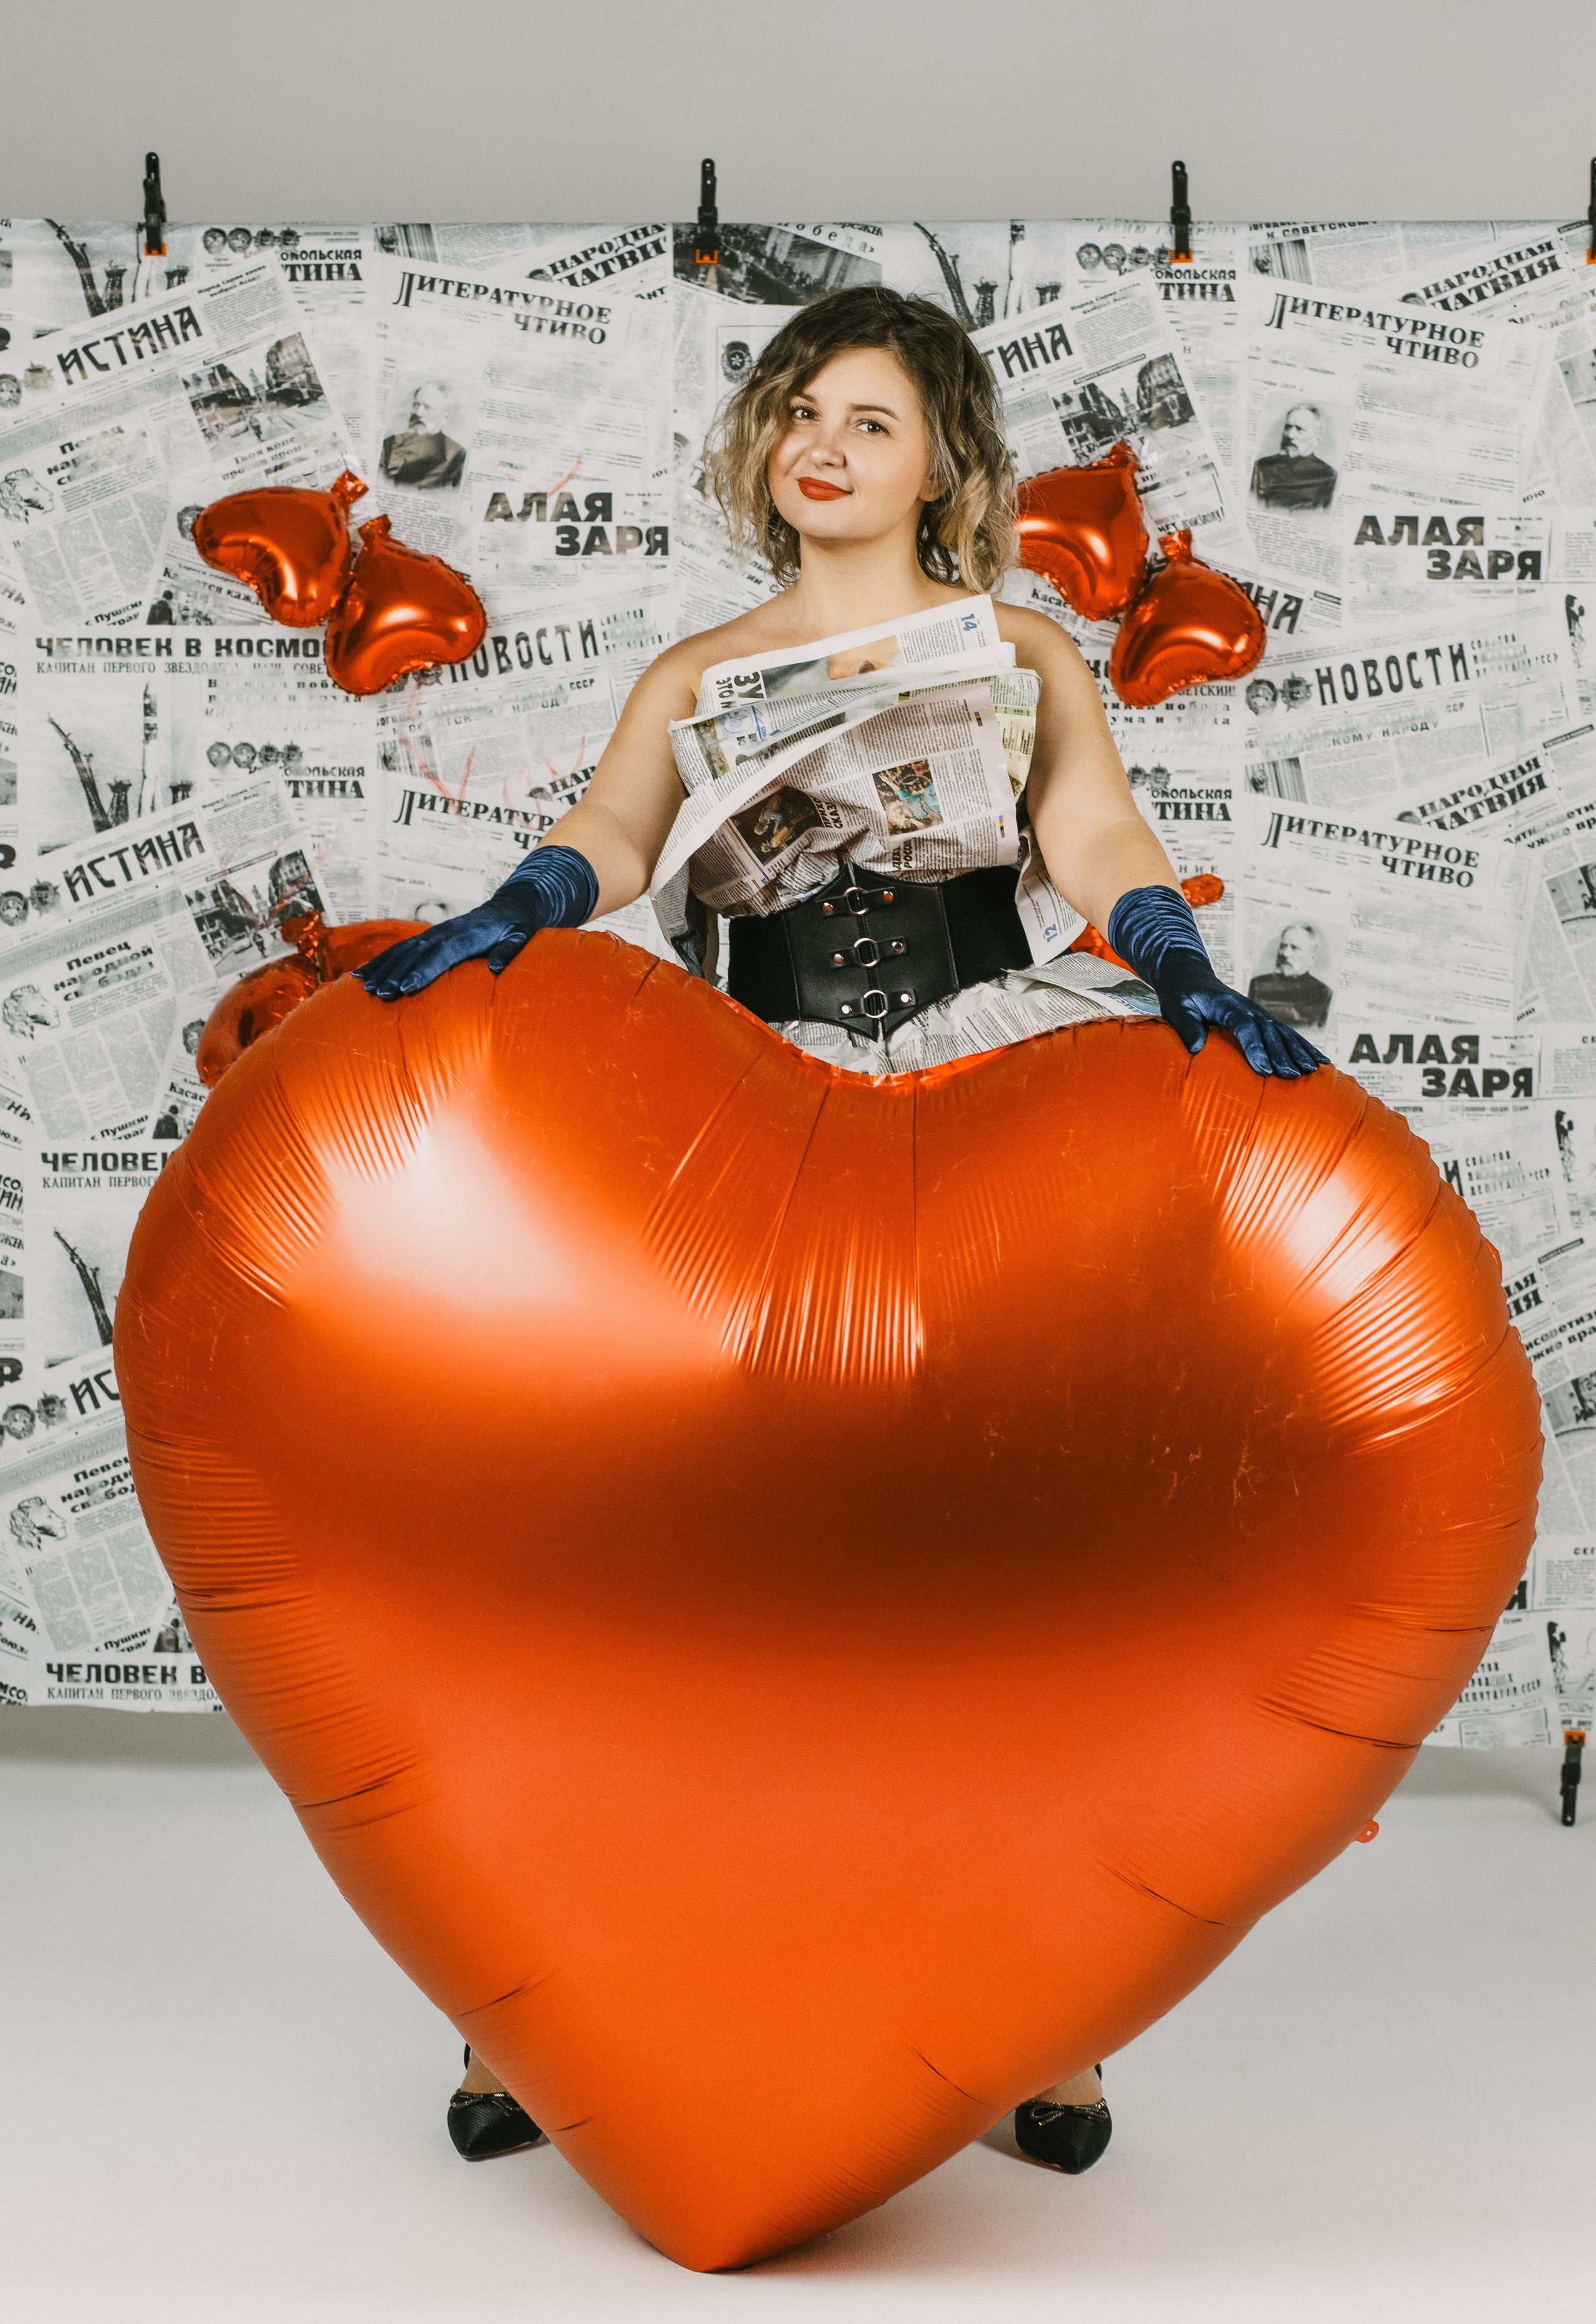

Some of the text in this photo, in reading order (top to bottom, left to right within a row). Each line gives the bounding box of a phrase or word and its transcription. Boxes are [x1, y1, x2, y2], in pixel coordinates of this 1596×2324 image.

[281, 249, 362, 261] ОМОЛЬСКАЯ
[549, 223, 666, 275] НАРОДНА
[557, 236, 666, 287] ЛАТВИ
[1153, 269, 1236, 281] ОМОЛЬСКАЯ
[1421, 241, 1555, 300] НАРОДНАЯ
[1430, 253, 1563, 312] ЛАТВИЯ
[393, 272, 611, 324] ЛИТЕРАТУРНОЕ
[513, 313, 607, 345] ЧТИВО
[1265, 293, 1485, 349] ЛИТЕРАТУРНОЕ
[57, 306, 203, 386] ИСТИНА
[1385, 336, 1479, 370] ЧТИВО
[483, 492, 613, 522] АЛАЯ
[555, 526, 669, 556] ЗАРЯ
[1353, 515, 1484, 546] АЛАЯ
[1427, 549, 1542, 580] ЗАРЯ
[961, 613, 978, 632] 14
[36, 638, 326, 658] ЧЕЛОВЕК В КОСМО
[37, 662, 95, 674] КАПИТАН
[103, 662, 156, 674] ПЕРВОГО
[1315, 642, 1470, 706] НОВОСТИ
[570, 678, 595, 691] СССР
[1147, 788, 1232, 800] ОМОЛЬСКАЯ
[1418, 756, 1542, 818] НАРОДНАЯ
[1426, 772, 1549, 831] ЛАТВИЯ
[393, 789, 560, 832] ЛИТЕРАТУР
[1152, 802, 1232, 821] ТИНА
[1261, 812, 1479, 869] ЛИТЕРАТУРНОЕ
[62, 820, 206, 903] ИСТИНА
[1381, 855, 1474, 889] ЧТИВО
[1044, 924, 1059, 943] 12
[54, 944, 153, 991] наодной
[67, 941, 131, 971] Певец
[1348, 1034, 1479, 1064] АЛАЯ
[1421, 1067, 1533, 1098] ЗАРЯ
[43, 1176, 100, 1189] КАПИТАН
[46, 1663, 206, 1684] ЧЕЛОВЕК В
[47, 1687, 103, 1700] КАПИТАН
[111, 1688, 162, 1701] ПЕРВОГО
